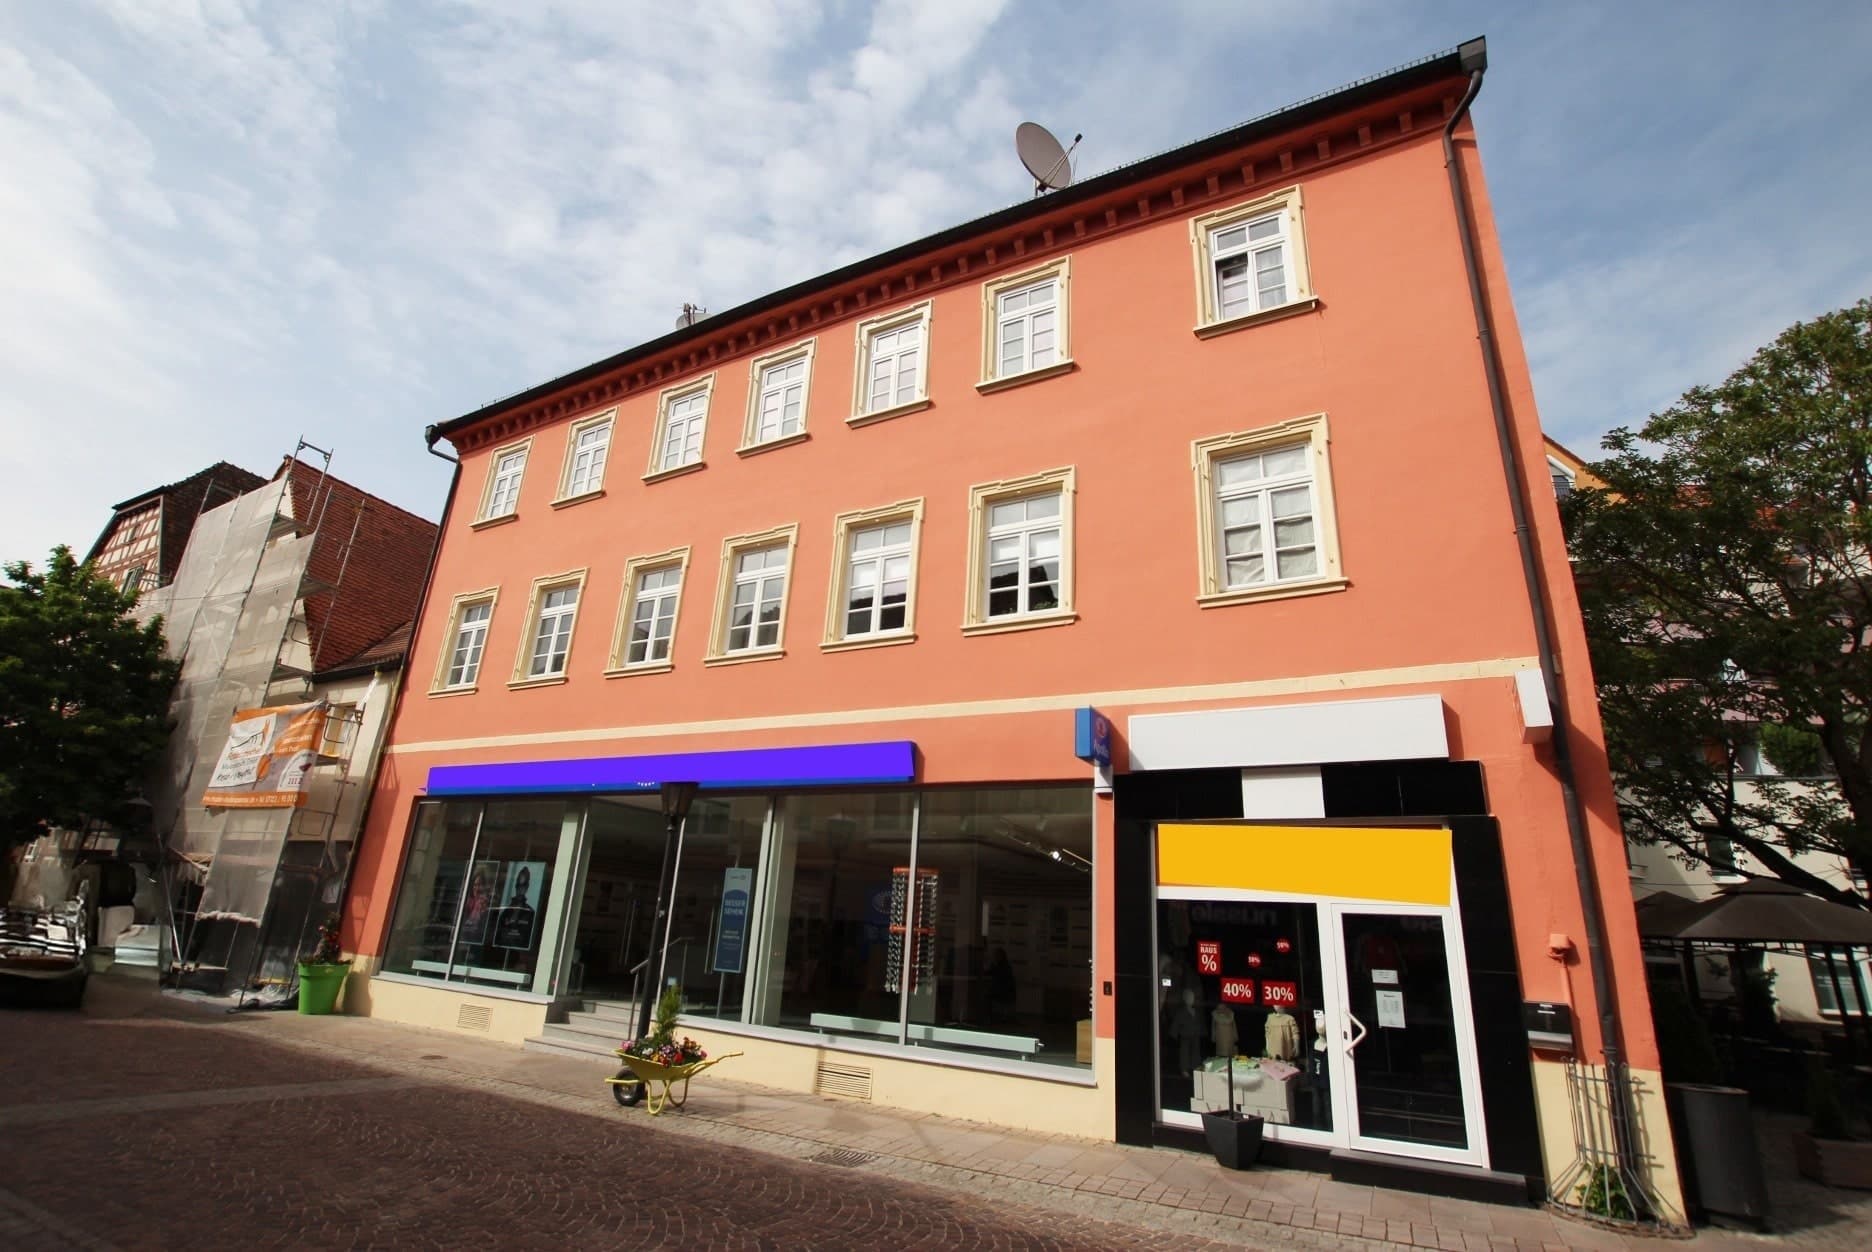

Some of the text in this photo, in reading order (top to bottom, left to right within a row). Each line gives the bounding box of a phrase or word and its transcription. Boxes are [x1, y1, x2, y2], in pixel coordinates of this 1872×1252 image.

[1200, 946, 1218, 954] RAUS
[1201, 954, 1217, 972] %
[1223, 982, 1252, 998] 40%
[1264, 985, 1294, 1002] 30%
